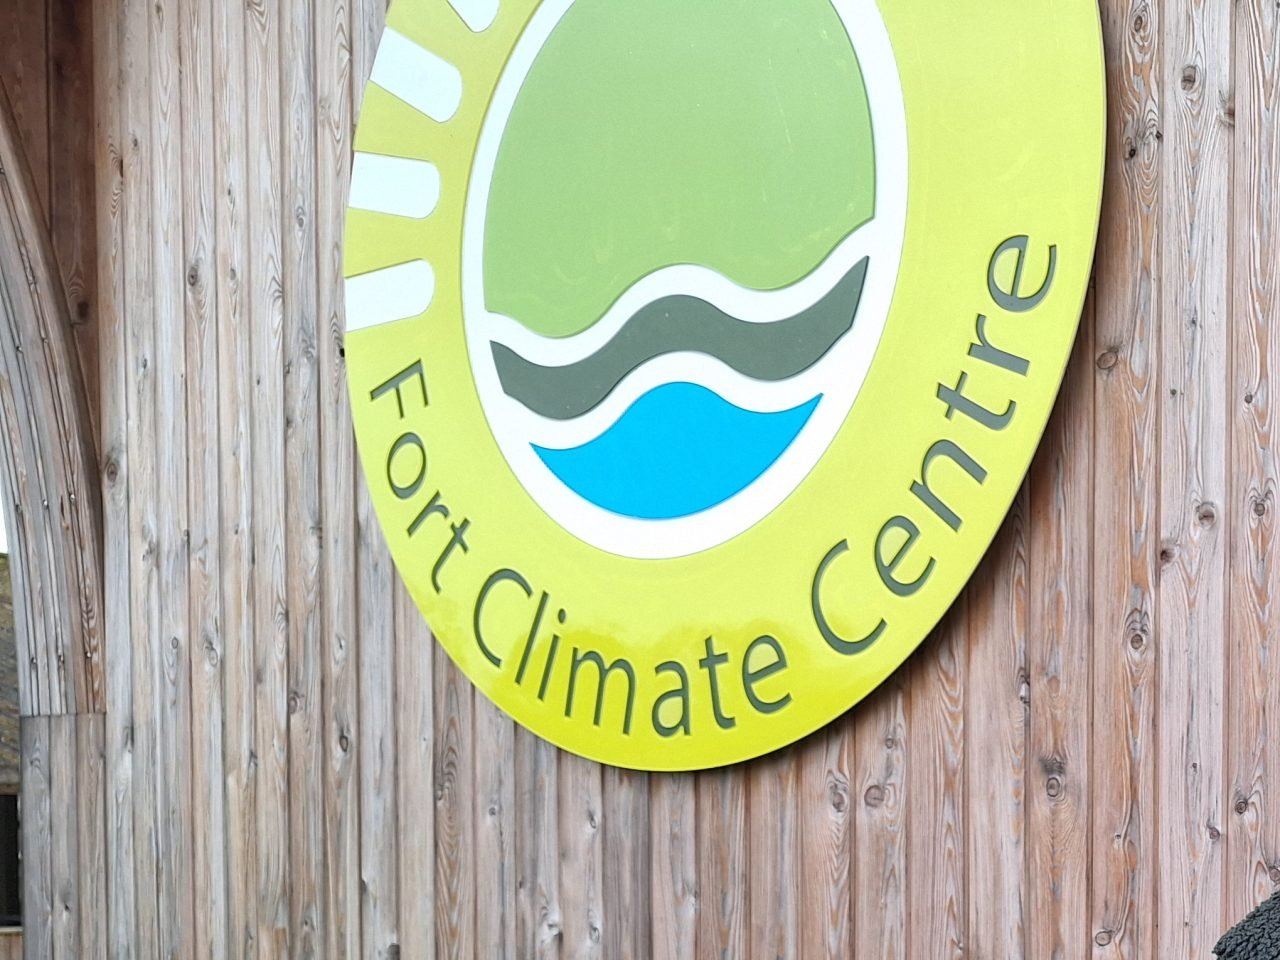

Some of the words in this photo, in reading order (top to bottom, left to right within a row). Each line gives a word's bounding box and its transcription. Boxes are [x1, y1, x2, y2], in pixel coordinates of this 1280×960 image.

[369, 358, 472, 594] Fort
[473, 567, 792, 738] Climate
[810, 234, 1057, 656] Centre
